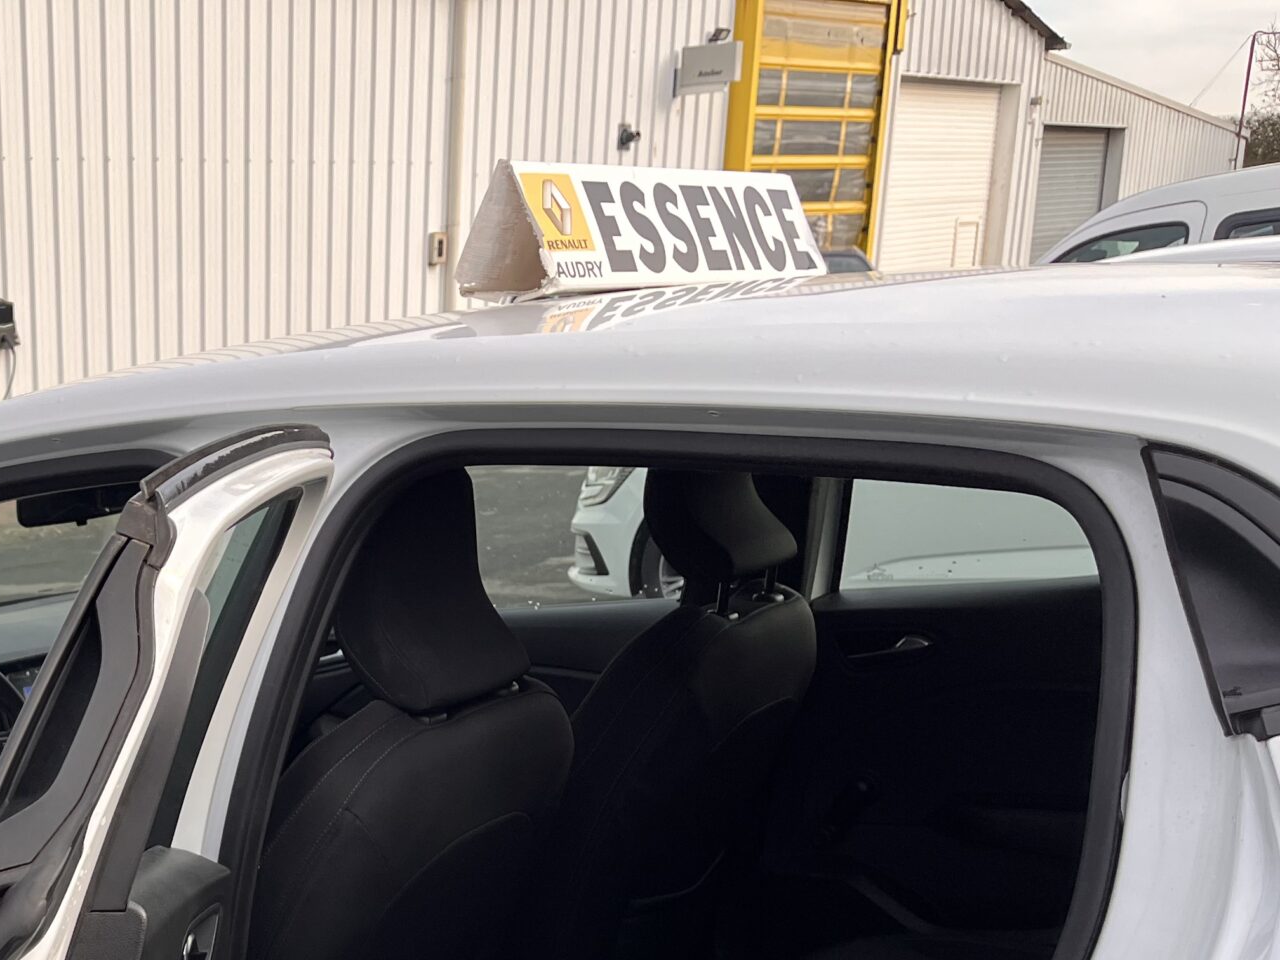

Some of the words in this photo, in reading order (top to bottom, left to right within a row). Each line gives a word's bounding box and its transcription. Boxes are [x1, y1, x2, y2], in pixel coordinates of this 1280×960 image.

[582, 181, 817, 273] ESSENCE
[546, 239, 588, 250] RENAULT
[556, 260, 603, 278] AUDRY
